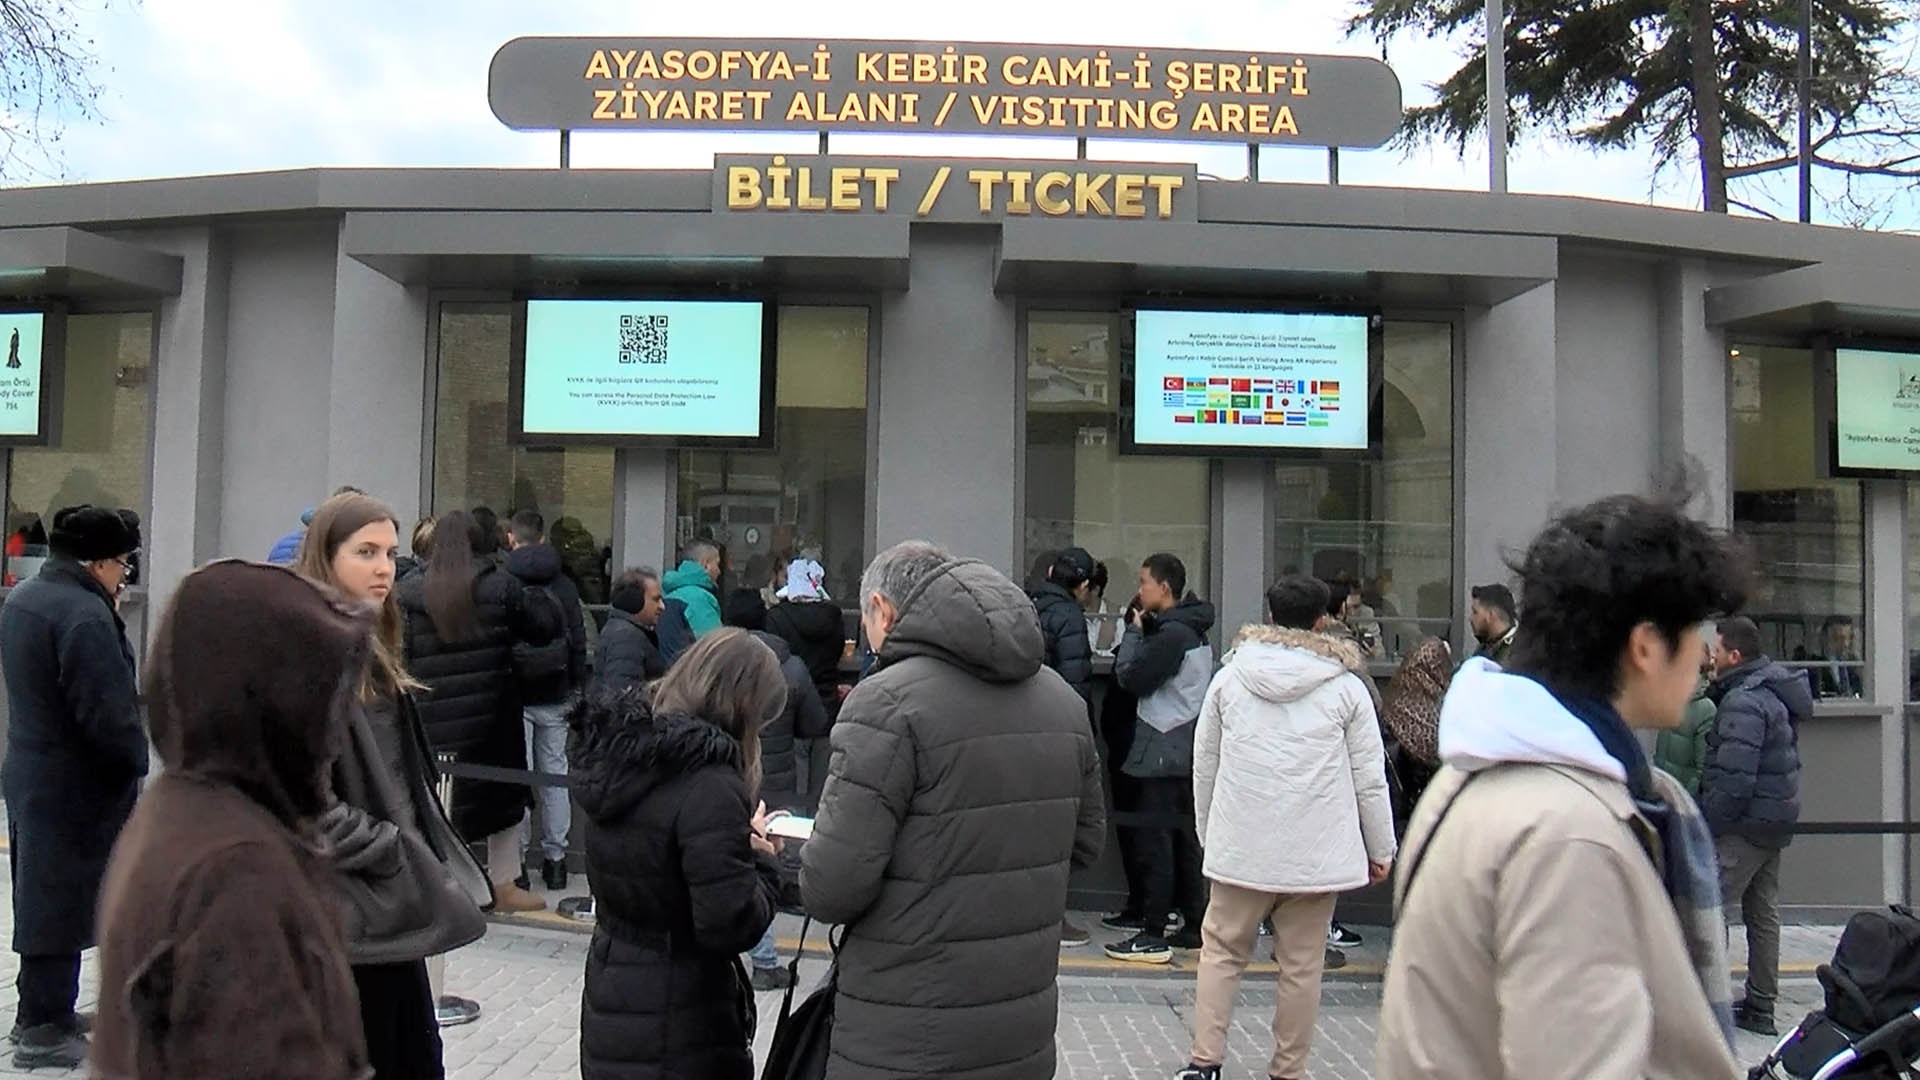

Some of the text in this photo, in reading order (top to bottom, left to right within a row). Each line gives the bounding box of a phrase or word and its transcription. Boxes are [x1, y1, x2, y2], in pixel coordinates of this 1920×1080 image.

[585, 44, 1310, 99] AYASOFYA-İ KEBİR CAMİ-İ ŞERİFİ
[592, 82, 1299, 136] ZİYARET ALANI / VISITING AREA
[727, 155, 1184, 219] BİLET / TICKET
[12, 389, 34, 398] Cover
